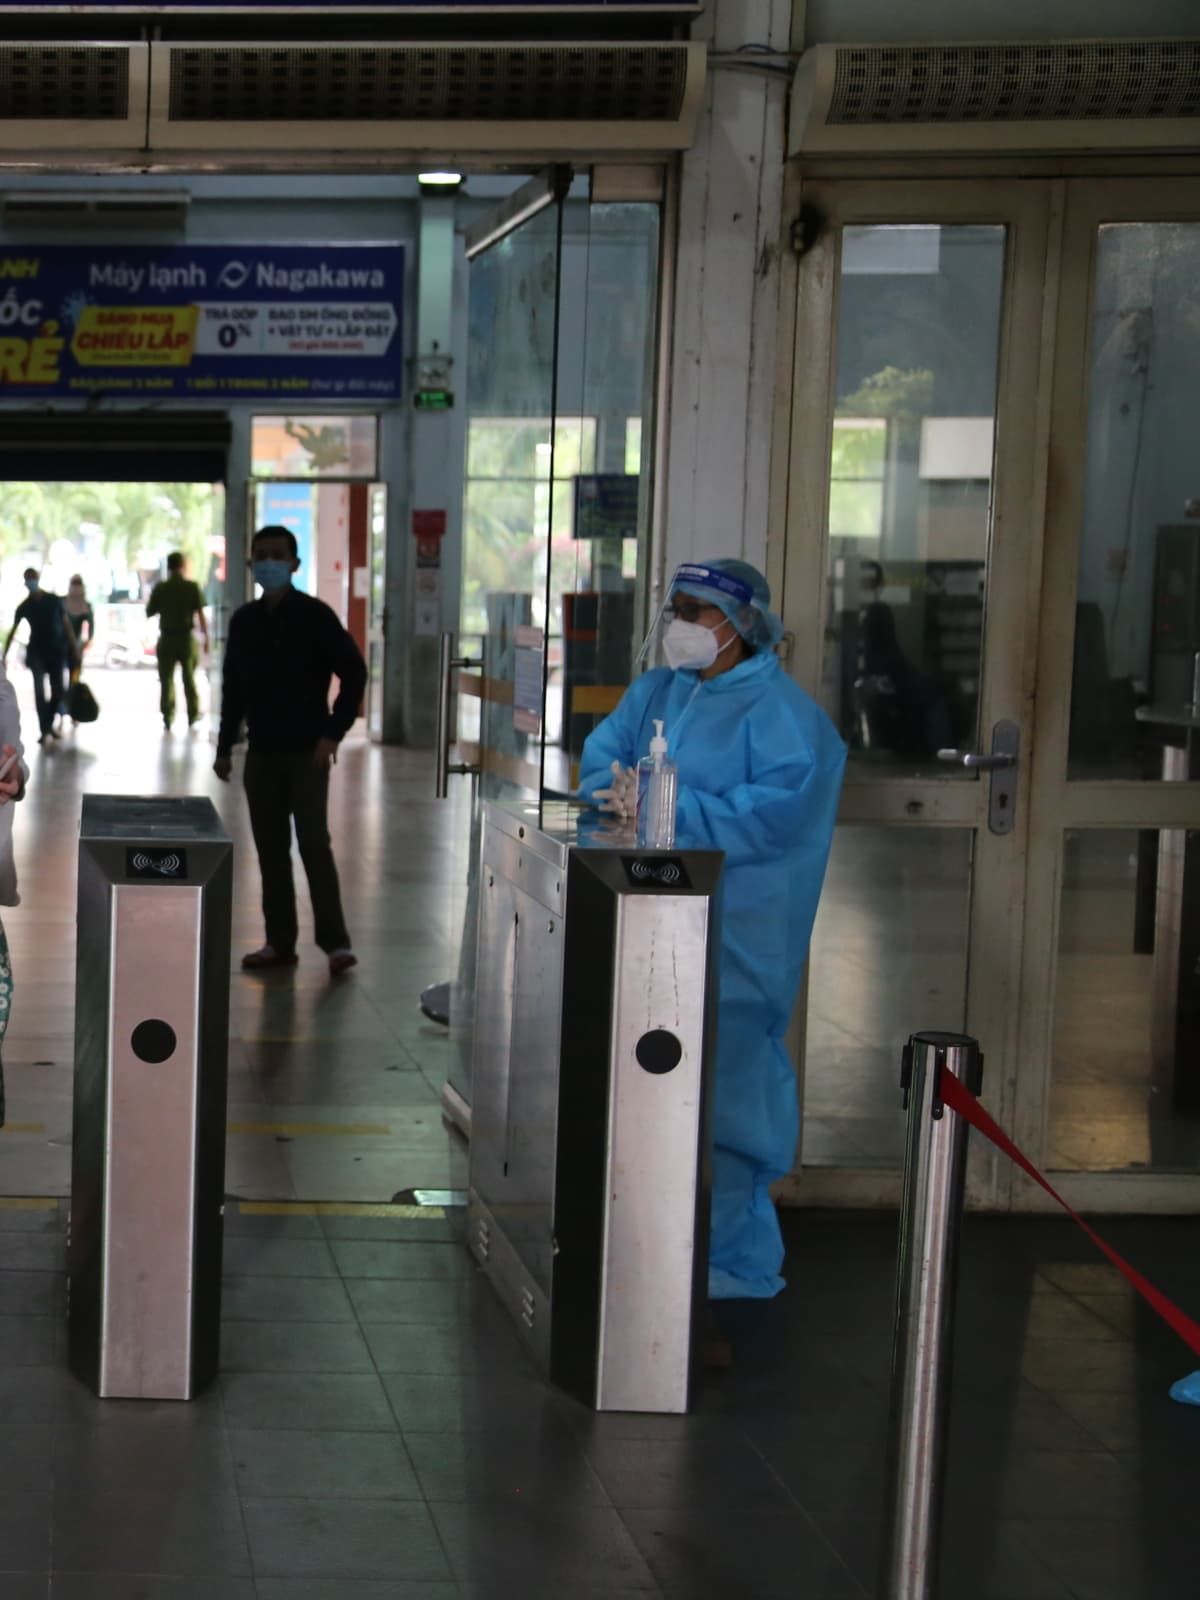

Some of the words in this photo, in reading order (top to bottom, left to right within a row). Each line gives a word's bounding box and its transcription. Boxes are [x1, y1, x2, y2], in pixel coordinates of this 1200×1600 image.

[89, 261, 145, 293] Máy
[149, 263, 208, 292] lạnh
[256, 262, 385, 292] Nagakawa
